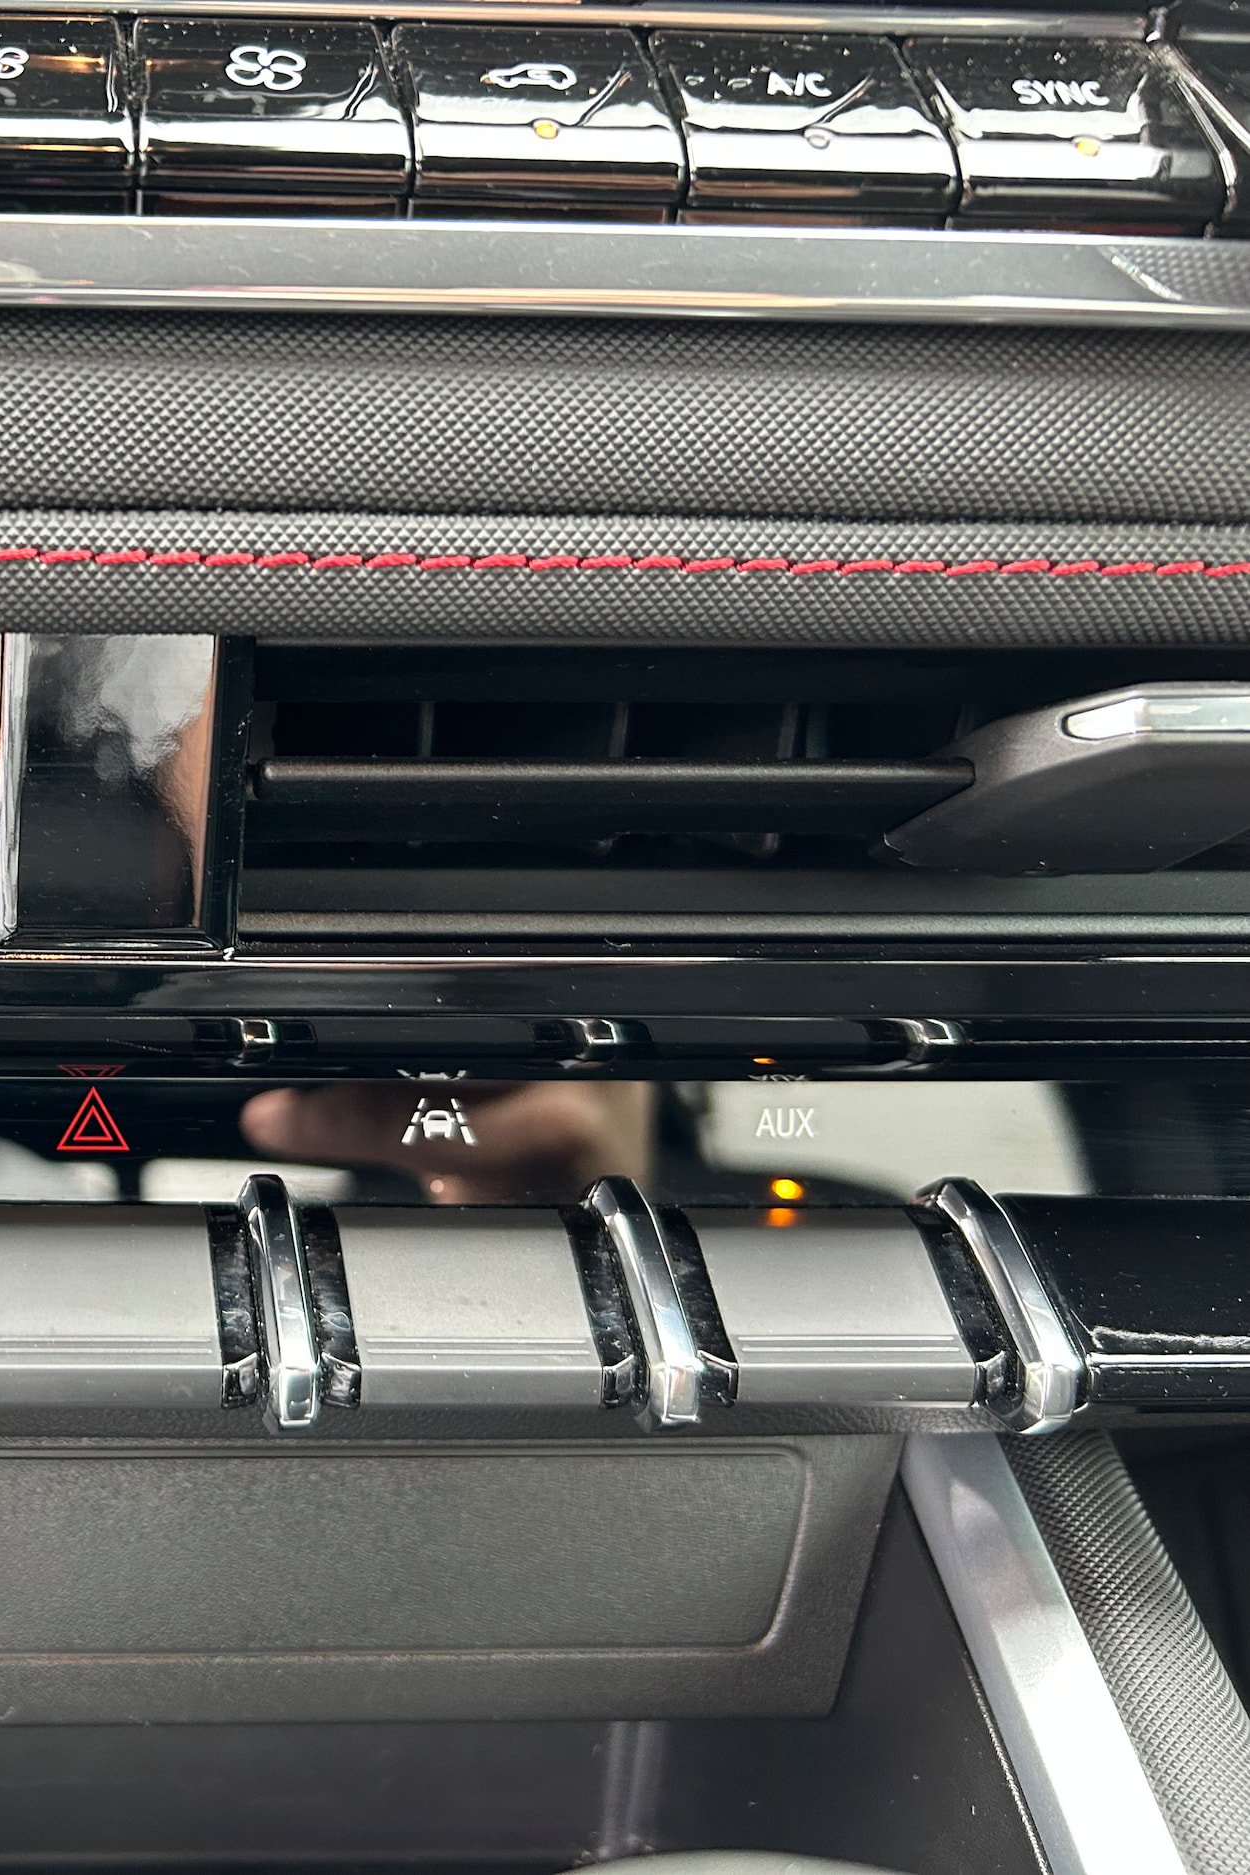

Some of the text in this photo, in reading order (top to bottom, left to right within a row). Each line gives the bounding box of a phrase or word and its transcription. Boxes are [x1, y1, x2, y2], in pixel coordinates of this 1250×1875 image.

[767, 71, 833, 97] A/C
[1012, 79, 1110, 106] SYNC
[755, 1107, 815, 1138] AUX
